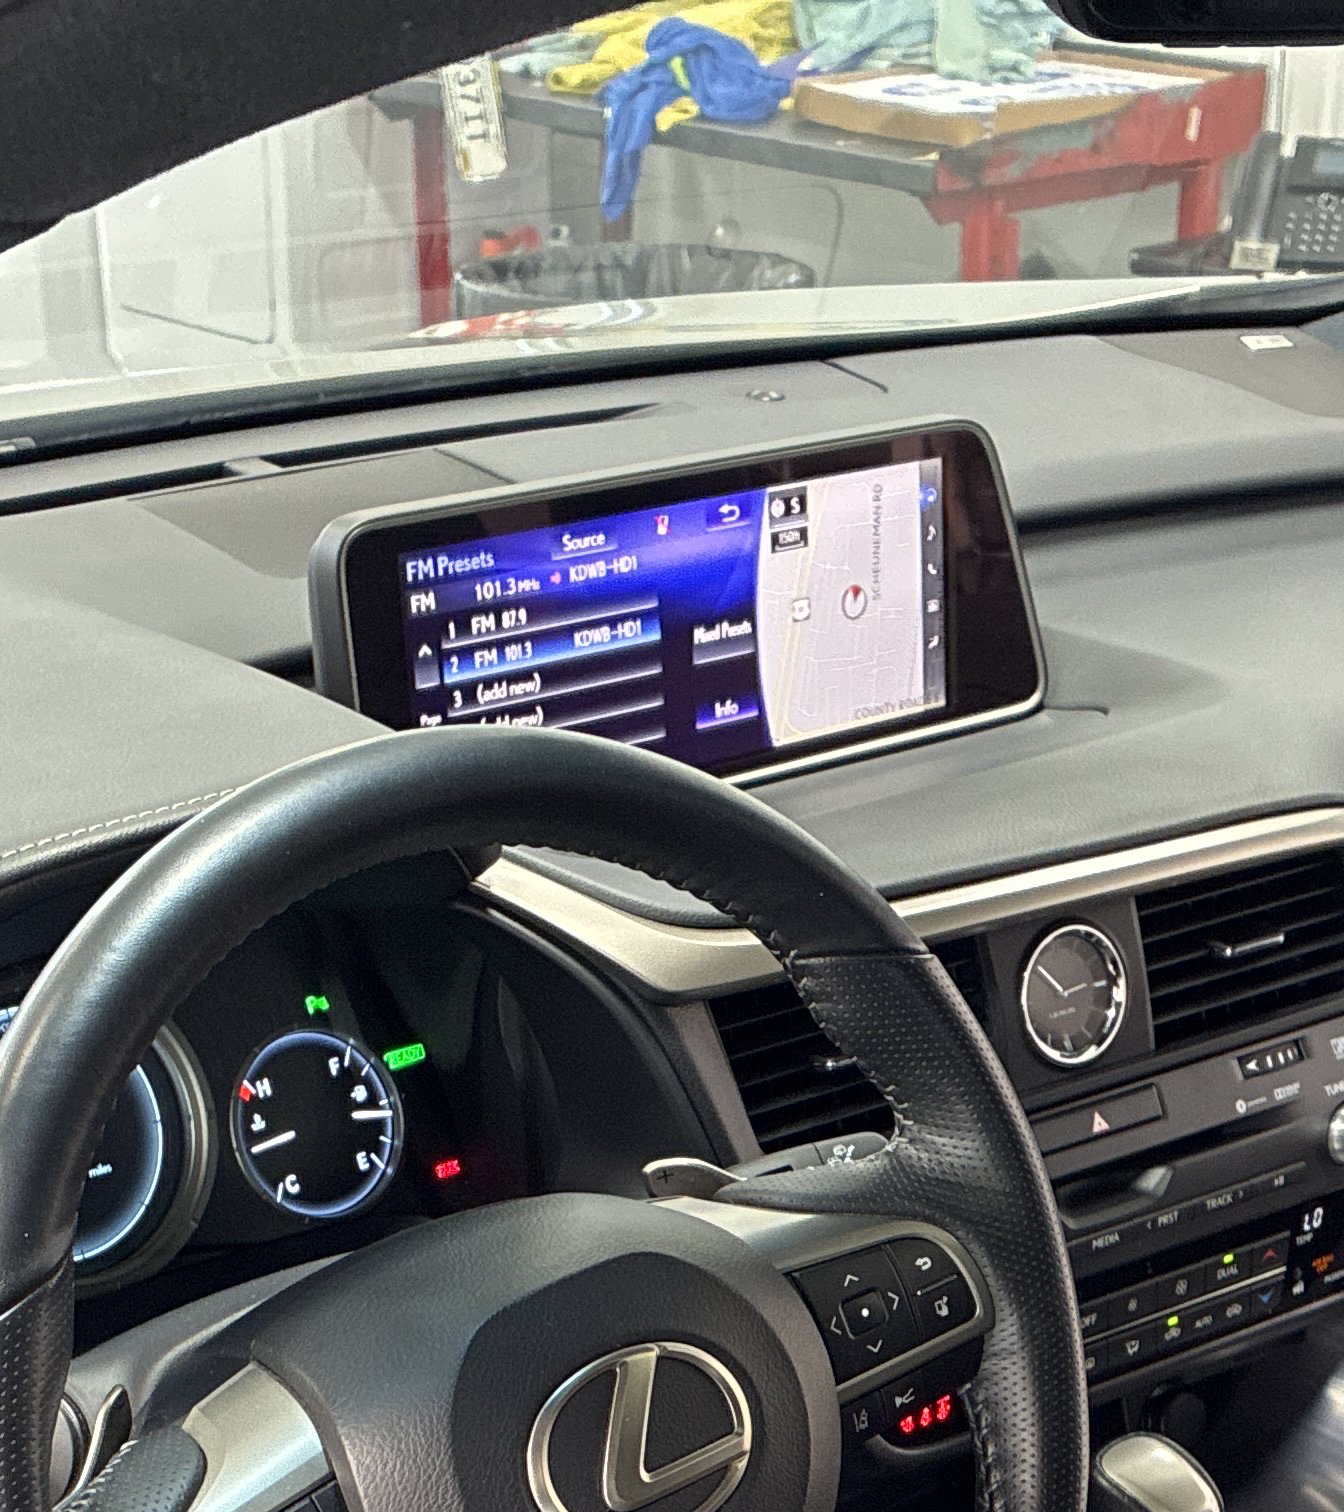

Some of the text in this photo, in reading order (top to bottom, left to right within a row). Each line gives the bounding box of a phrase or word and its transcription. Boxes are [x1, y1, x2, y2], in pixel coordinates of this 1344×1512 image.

[790, 497, 801, 514] S
[561, 532, 605, 551] Source
[406, 551, 495, 582] FM Presets
[568, 554, 638, 583] KDWB-HD1
[410, 591, 436, 614] FM
[447, 607, 527, 640] 1 FM 87.9
[450, 655, 459, 674] 2
[474, 648, 498, 668] FM
[573, 618, 642, 648] KDWB-HD1
[453, 671, 542, 708] 3 (add new)
[714, 698, 739, 719] Info
[328, 1056, 340, 1077] F
[256, 1077, 272, 1099] H
[356, 1151, 370, 1172] E
[285, 1174, 301, 1195] C
